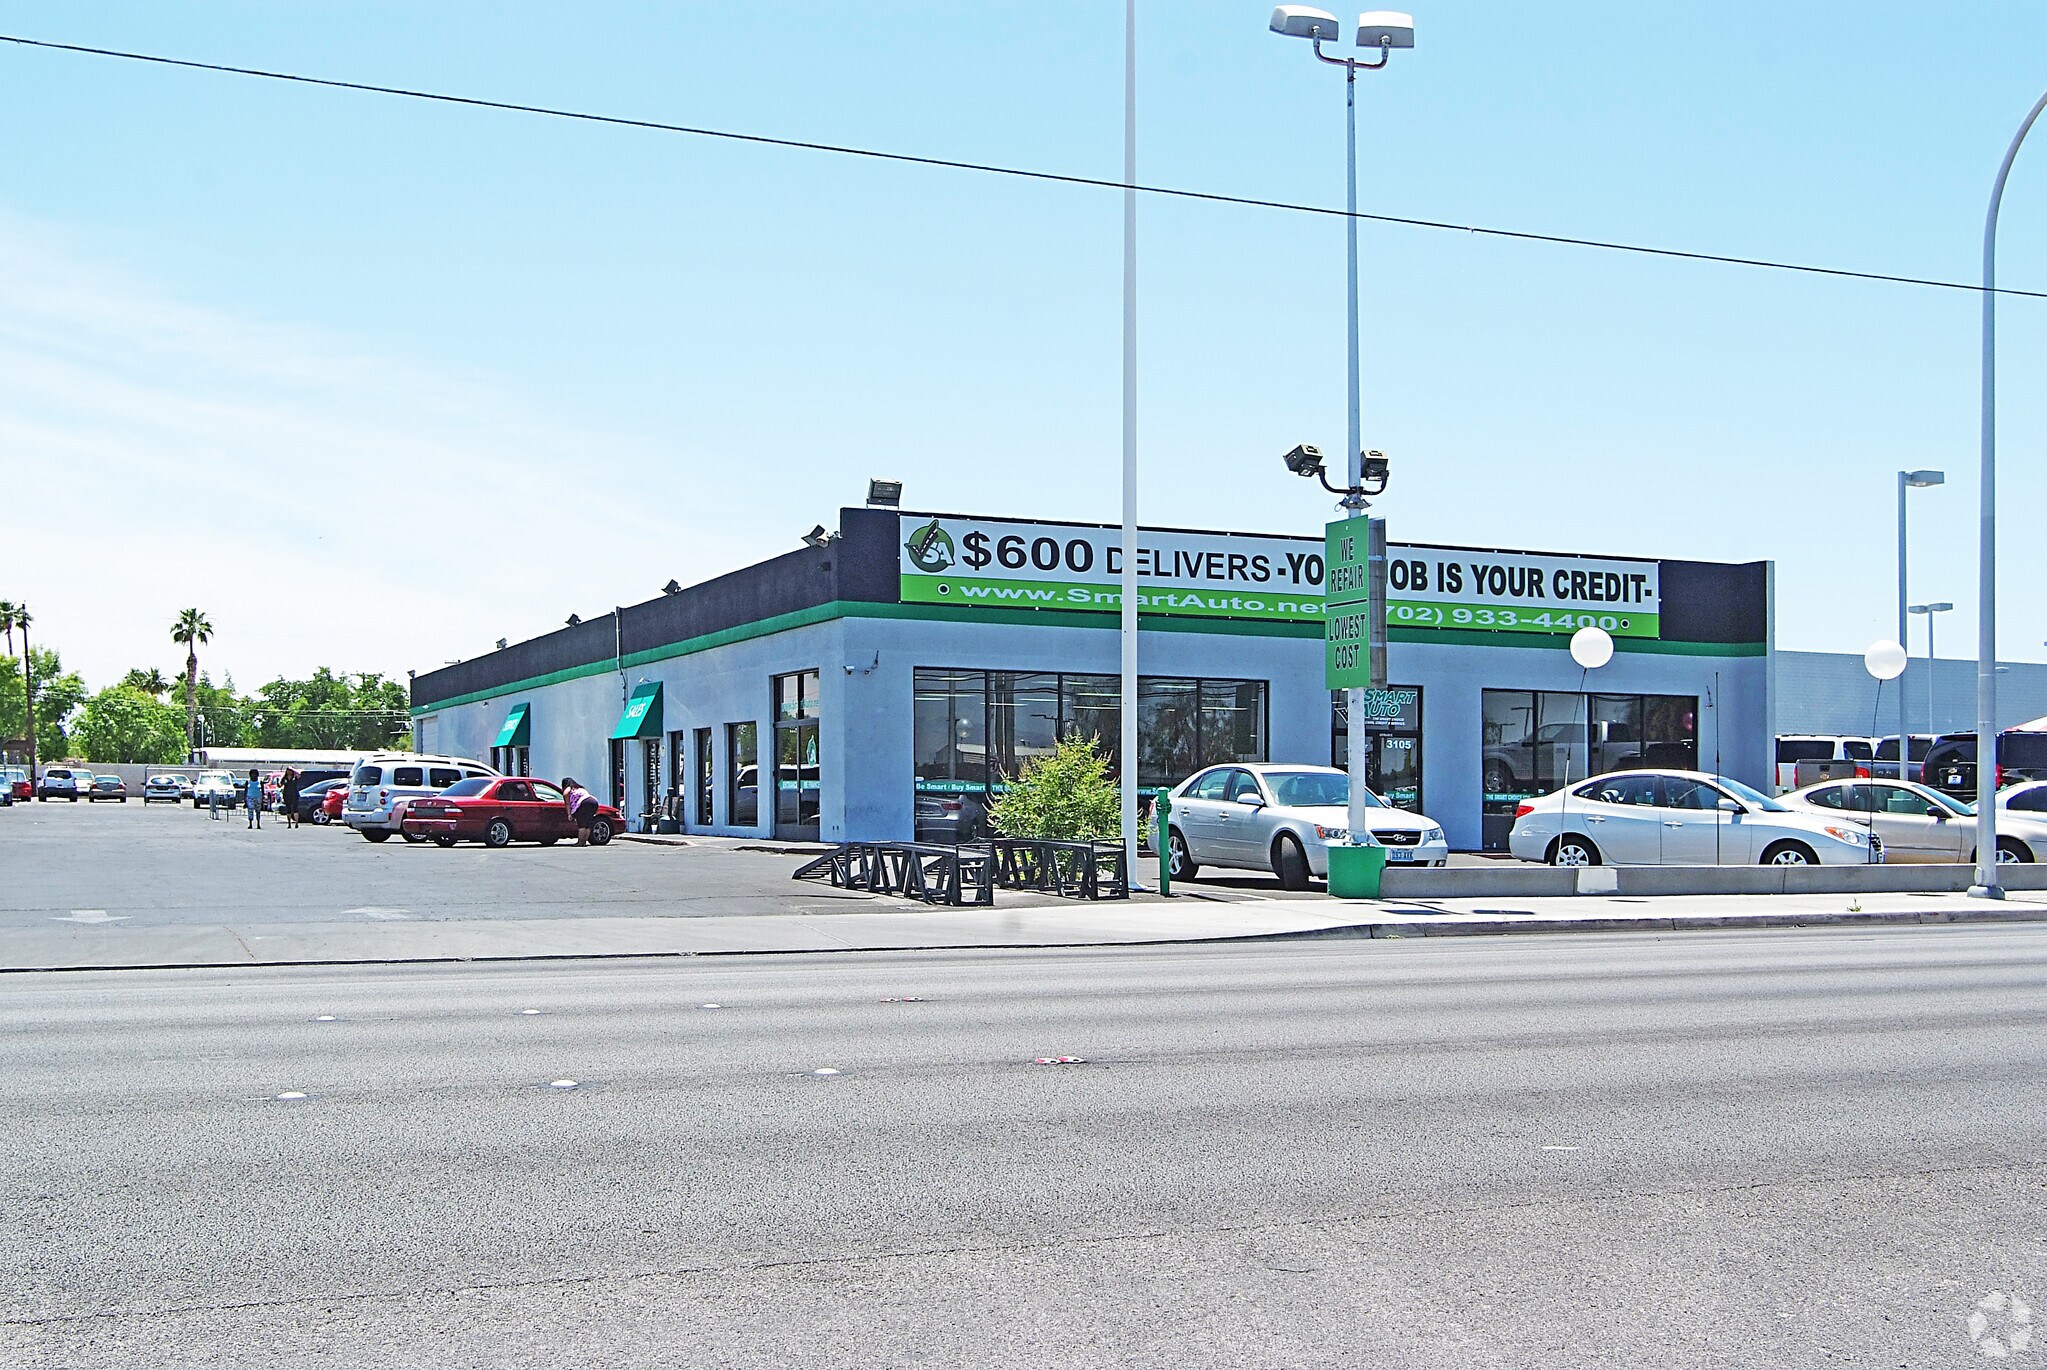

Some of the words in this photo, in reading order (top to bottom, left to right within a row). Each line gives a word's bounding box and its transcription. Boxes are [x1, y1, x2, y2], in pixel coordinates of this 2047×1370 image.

[1340, 537, 1354, 562] WE
[961, 530, 1094, 573] $600
[1106, 546, 1271, 583] DELIVERS
[1387, 559, 1428, 591] OB
[1437, 562, 1463, 594] IS
[1470, 564, 1545, 598] YOUR
[1553, 569, 1652, 604] CREDIT-
[1330, 564, 1365, 592] REPAIR
[1329, 613, 1366, 643] LOWEST
[1452, 608, 1618, 631] 933-4400
[1335, 644, 1360, 670] COST
[1364, 688, 1417, 704] SMART
[626, 702, 647, 719] SALES
[1386, 740, 1411, 749] 3105
[951, 784, 964, 792] Buy
[1395, 791, 1415, 800] Smart
